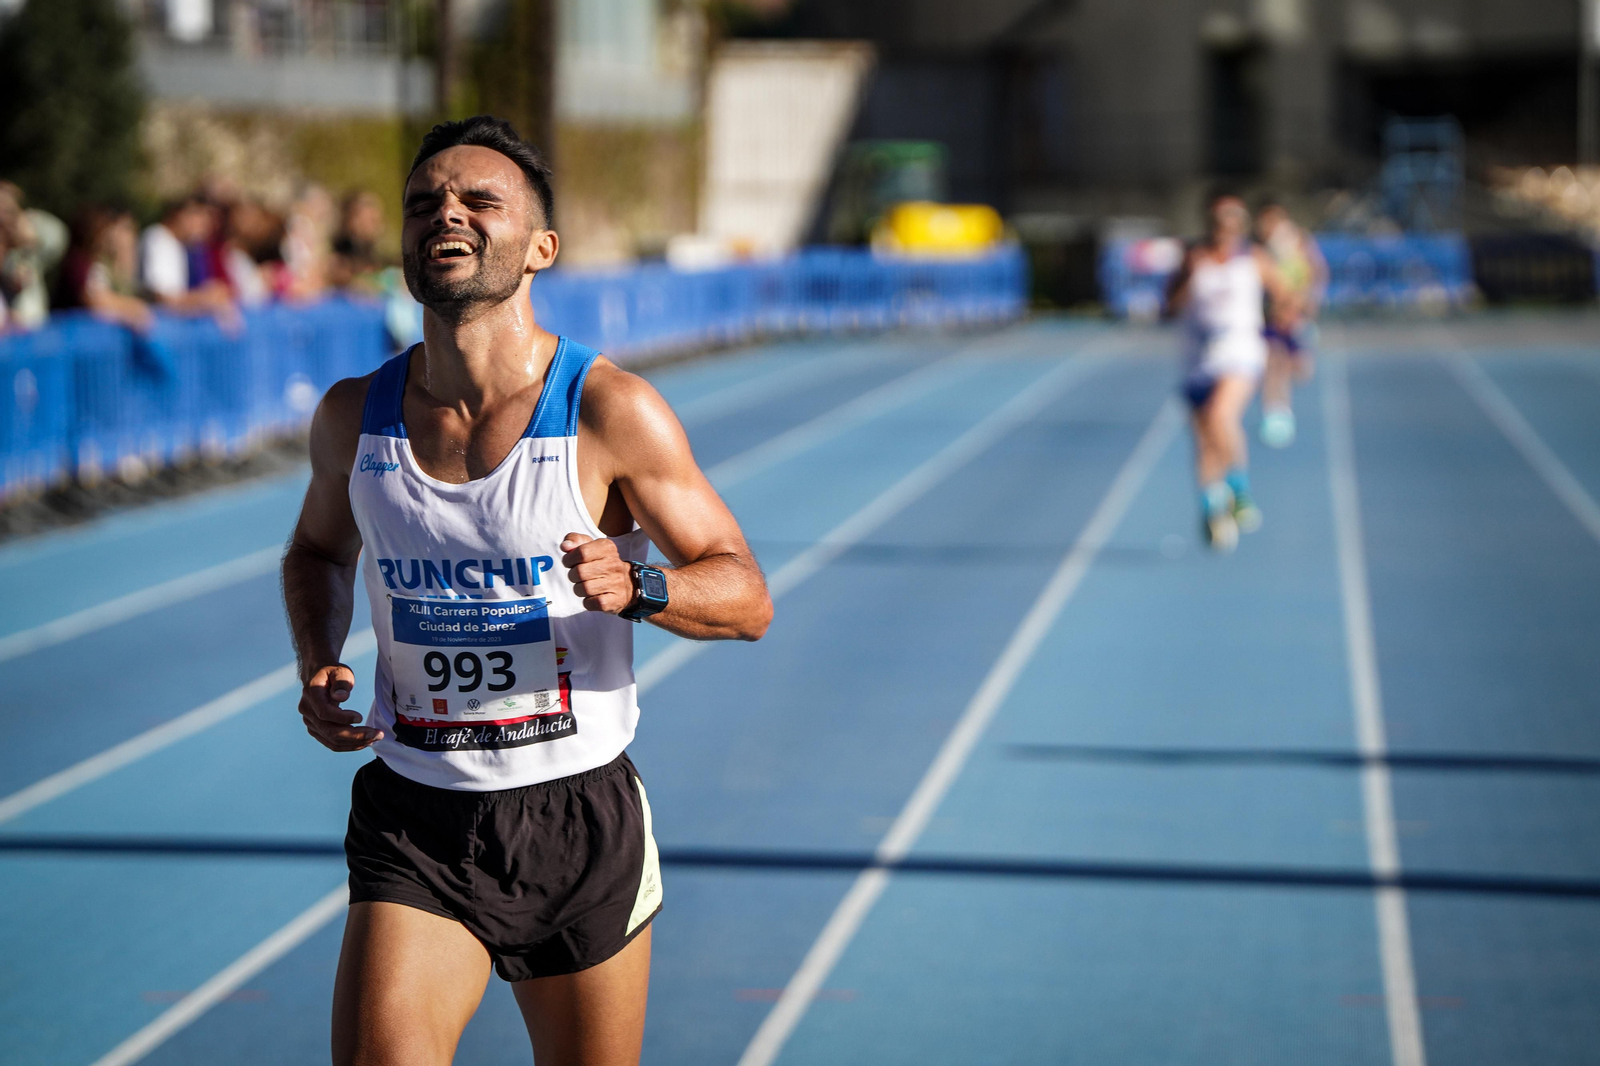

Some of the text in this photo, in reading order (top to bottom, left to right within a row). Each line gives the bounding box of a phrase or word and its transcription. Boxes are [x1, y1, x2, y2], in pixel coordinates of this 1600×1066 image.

[360, 453, 399, 477] Clapper
[377, 555, 553, 589] RUNCHIP
[408, 603, 534, 617] XLIII Carrera Popular
[418, 621, 516, 632] Ciudad de Jerez
[423, 651, 516, 692] 993
[424, 715, 572, 749] El café de Andalucía
